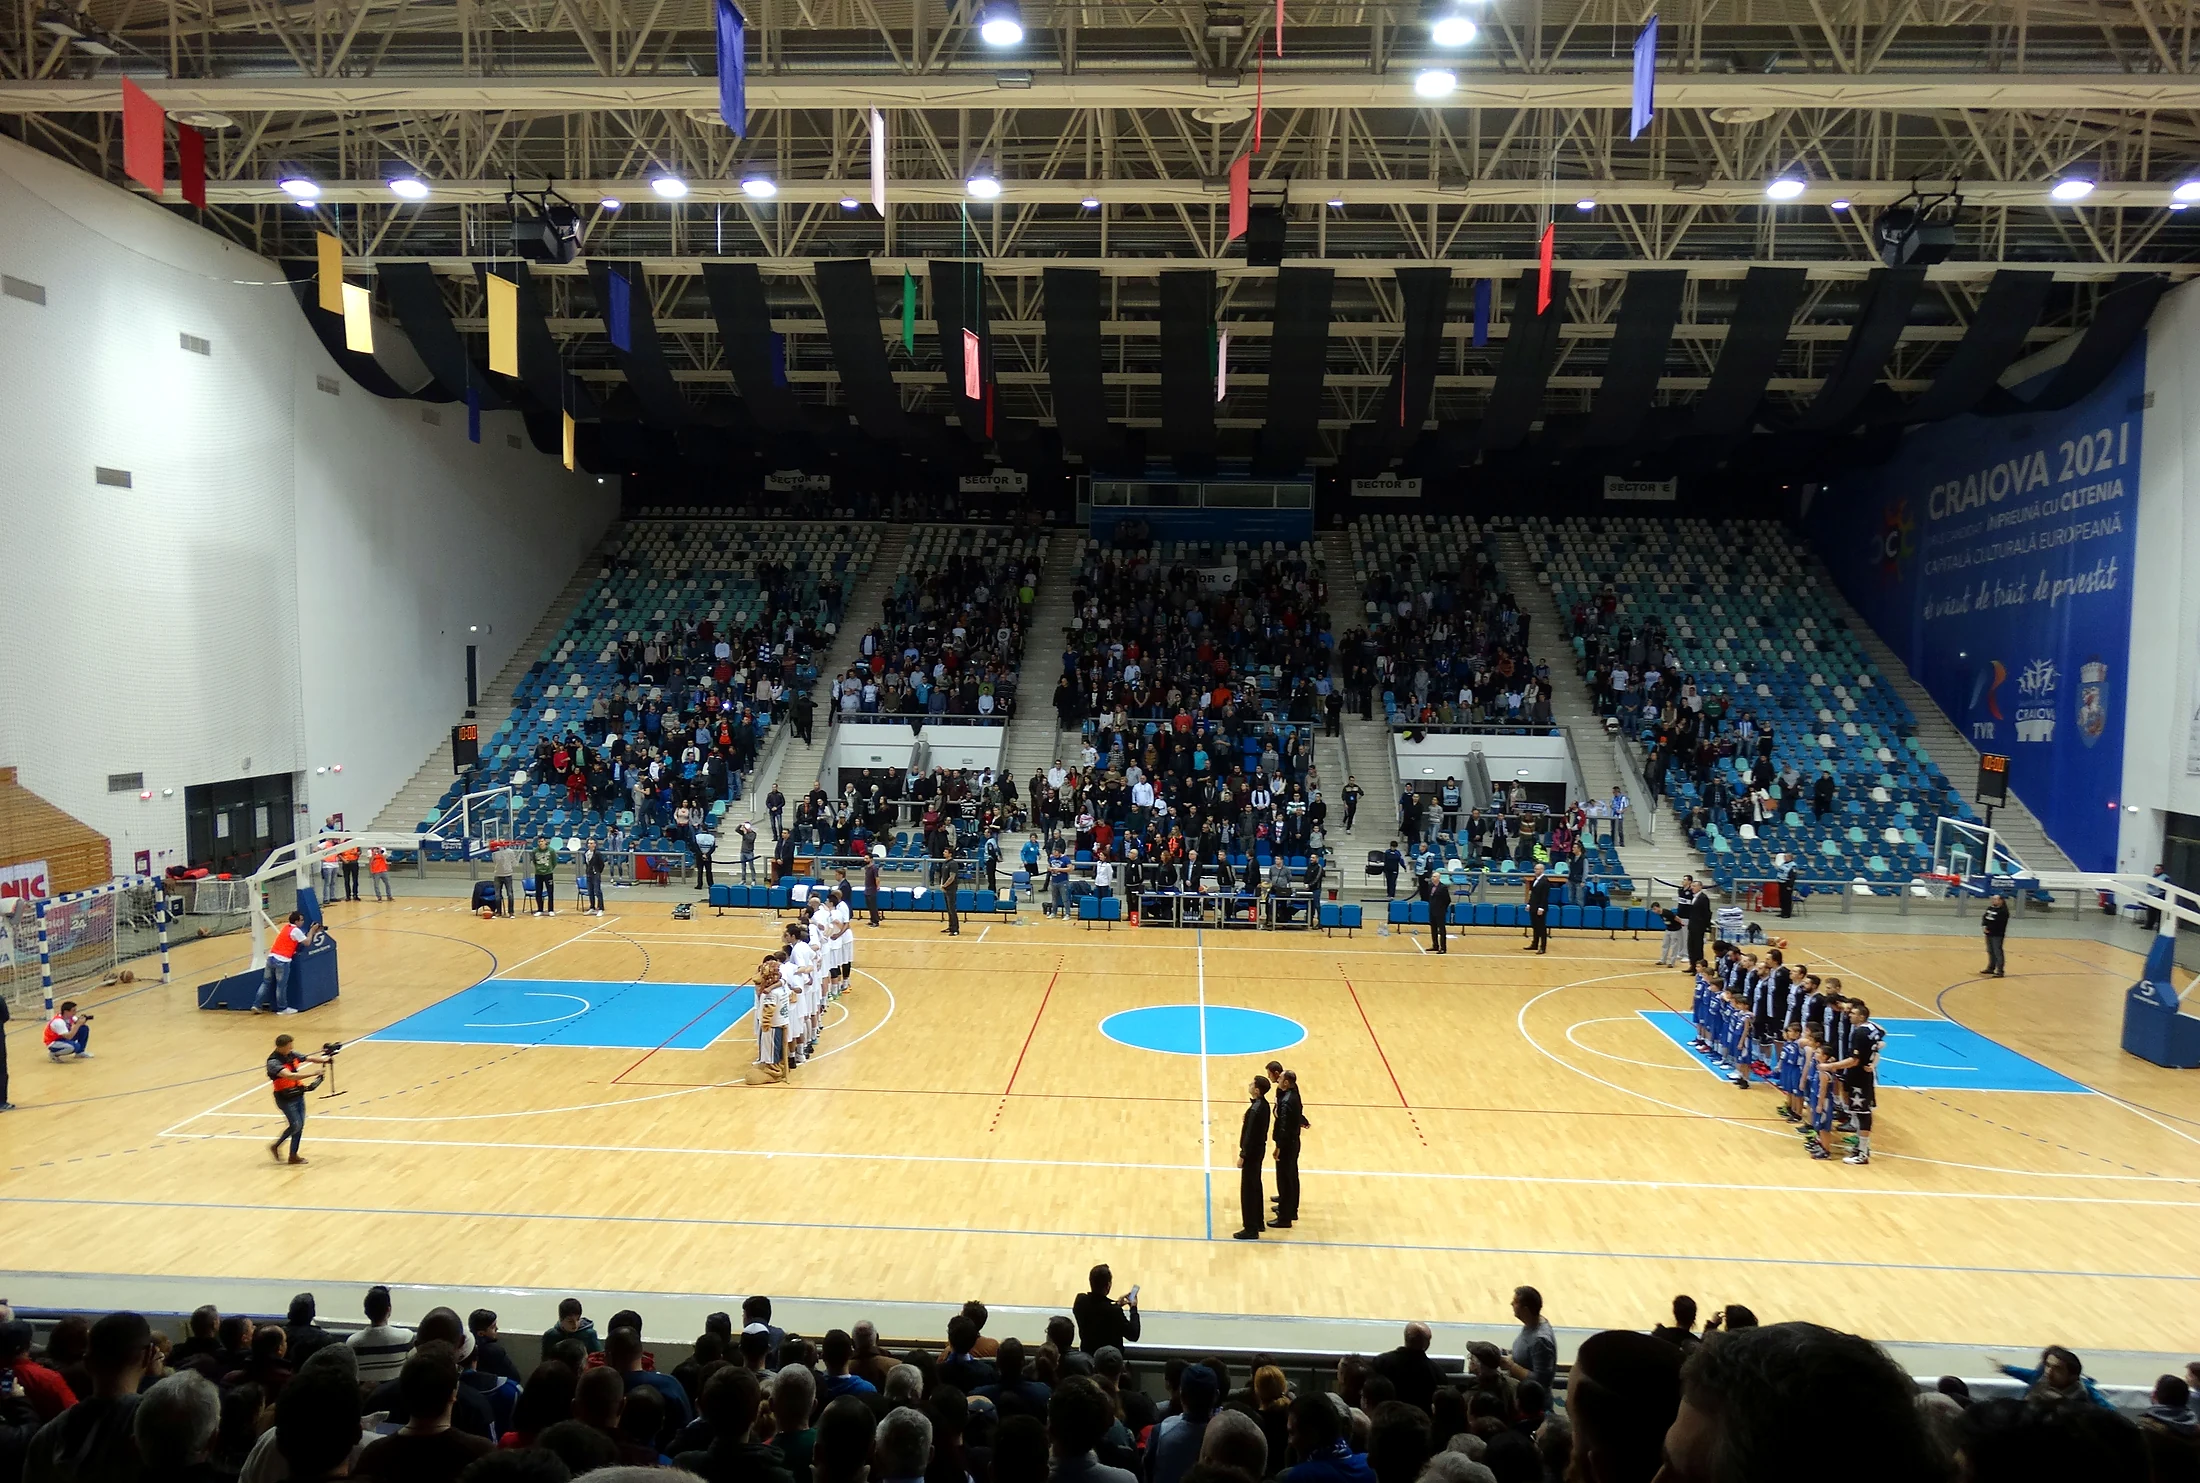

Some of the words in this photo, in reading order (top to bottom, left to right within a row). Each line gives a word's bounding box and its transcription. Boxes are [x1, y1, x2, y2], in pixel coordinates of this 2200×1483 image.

[1928, 450, 2049, 520] CRAIOVA
[2057, 422, 2129, 482] 2021
[770, 475, 811, 484] SECTOR
[965, 476, 1009, 484] SECTOR
[1015, 476, 1023, 484] B
[1356, 480, 1402, 488] SECTOR
[1408, 480, 1416, 488] D
[1609, 483, 1656, 491] SECTOR
[1663, 483, 1670, 491] E
[2042, 500, 2060, 516] CU
[1973, 722, 1995, 739] TVR
